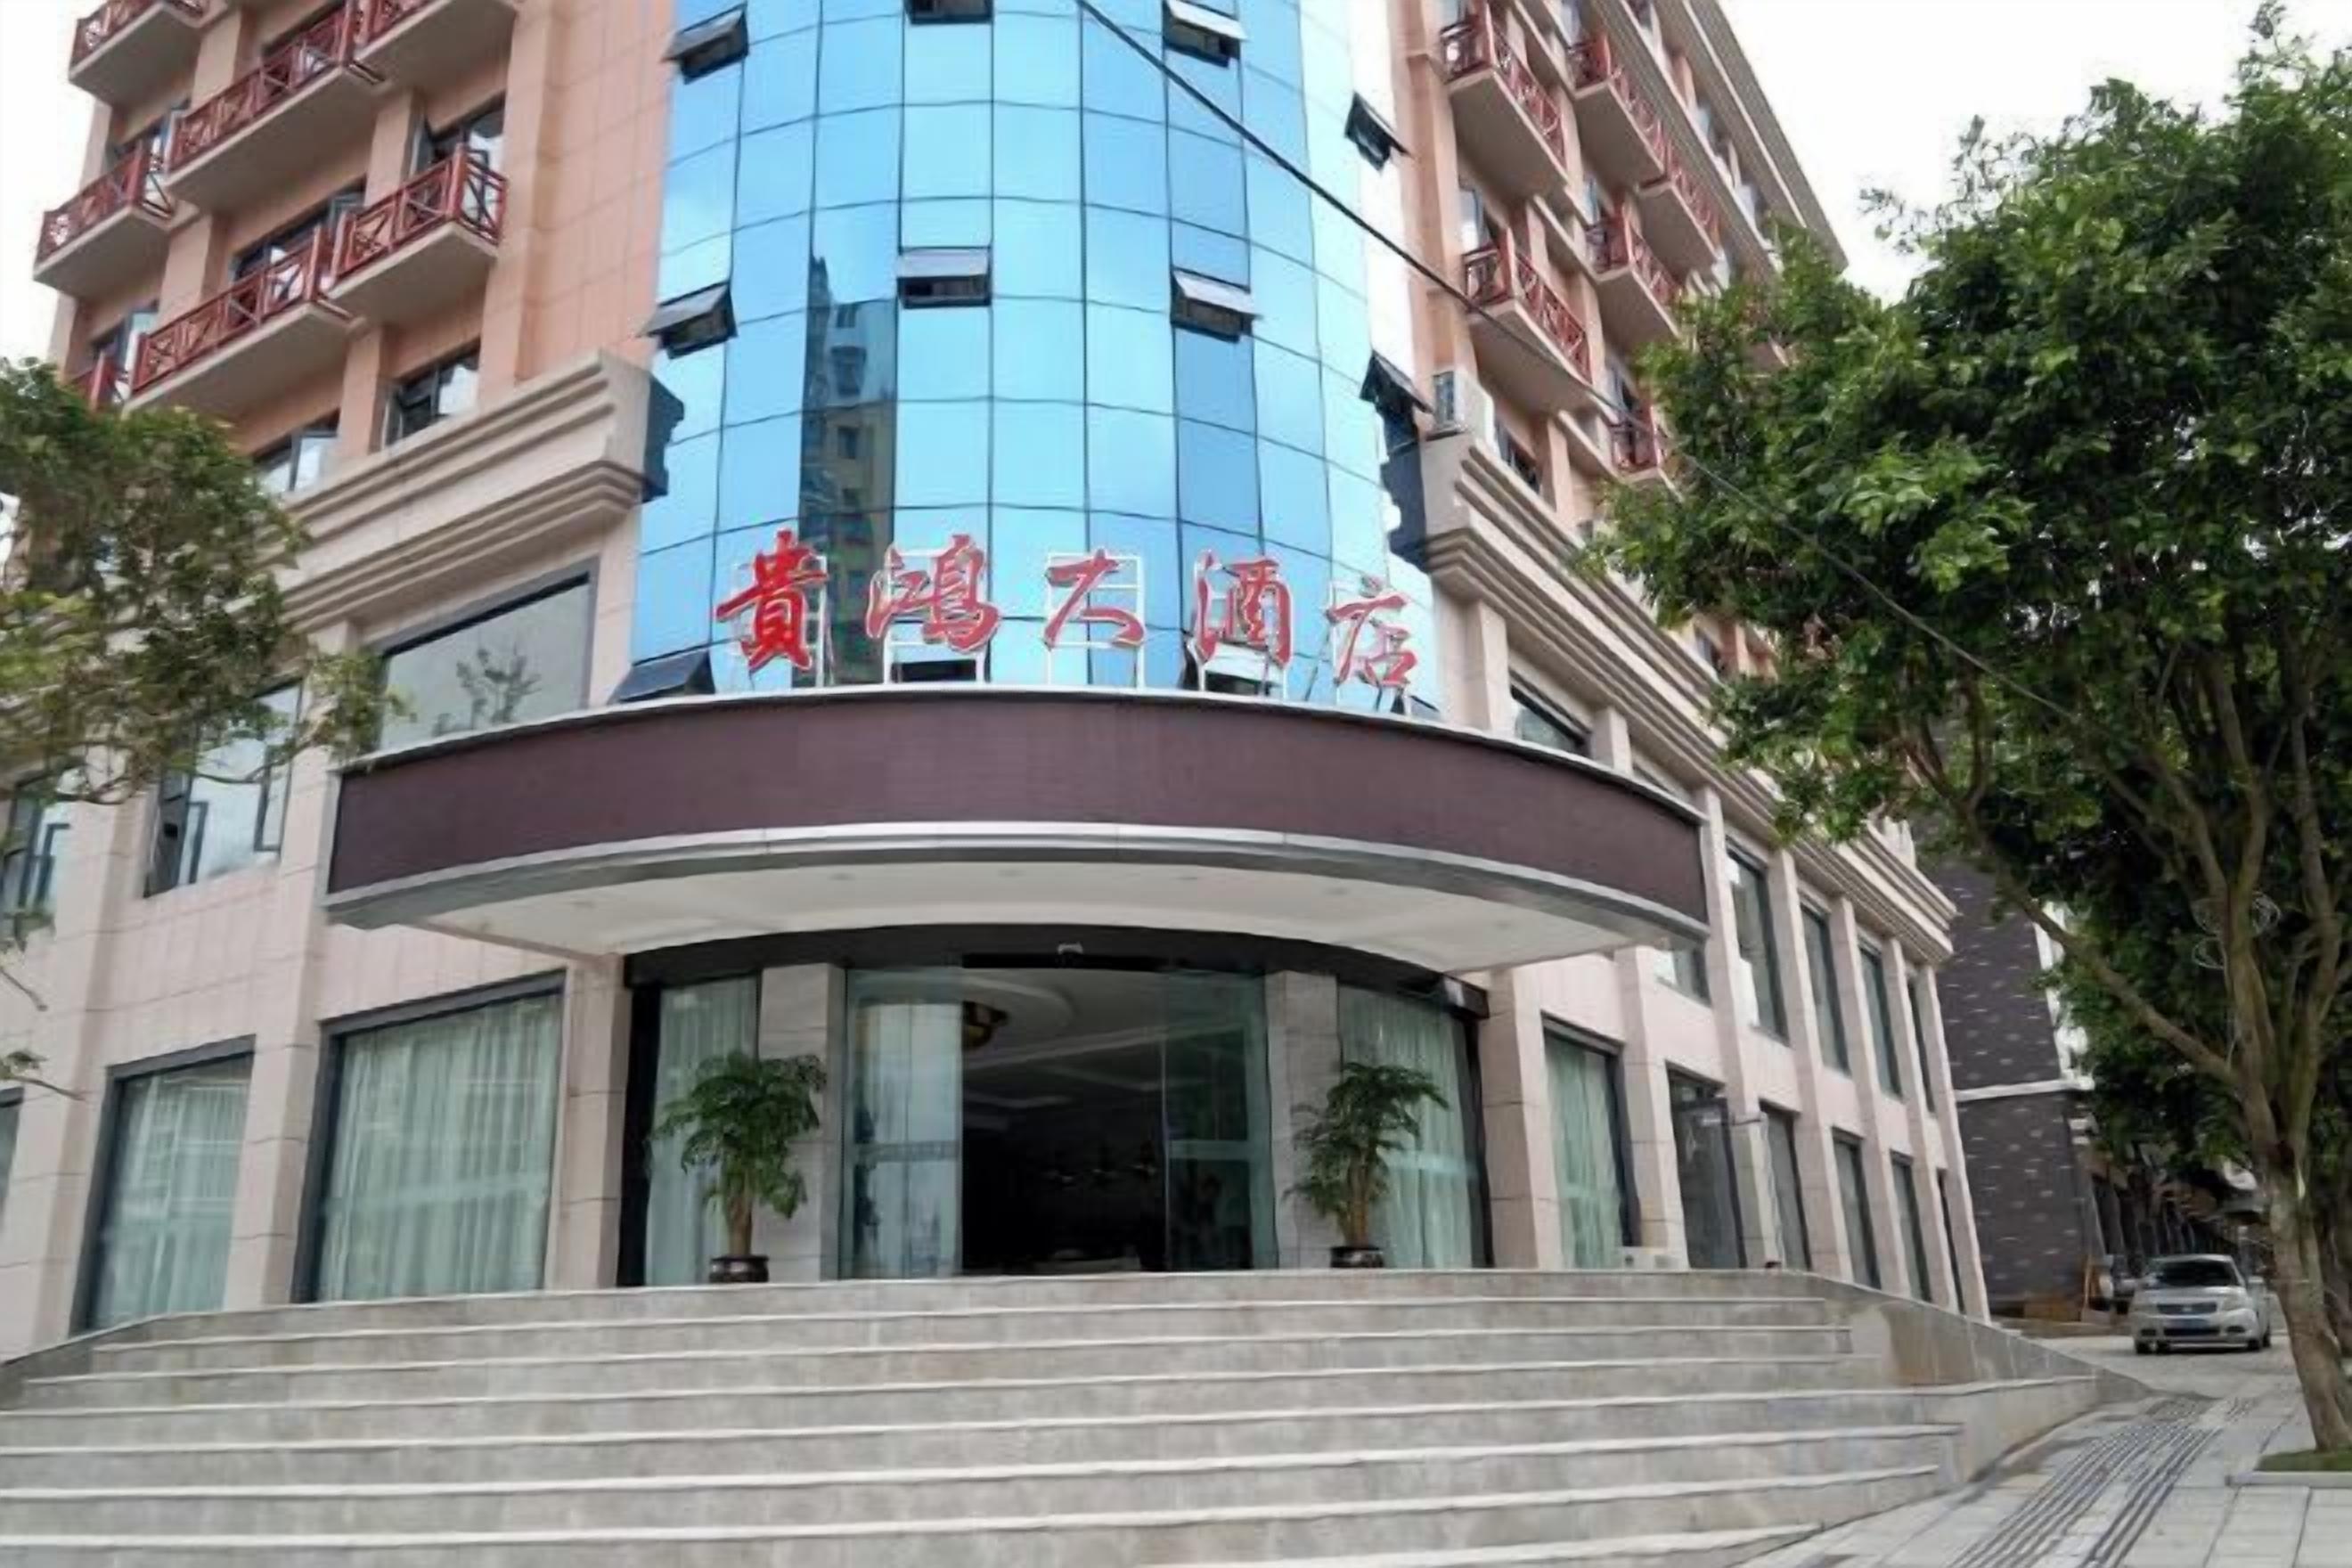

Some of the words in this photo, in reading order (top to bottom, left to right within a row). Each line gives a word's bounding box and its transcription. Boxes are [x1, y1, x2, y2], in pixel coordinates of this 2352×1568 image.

[716, 529, 1417, 686] 貴鴻大酒店
